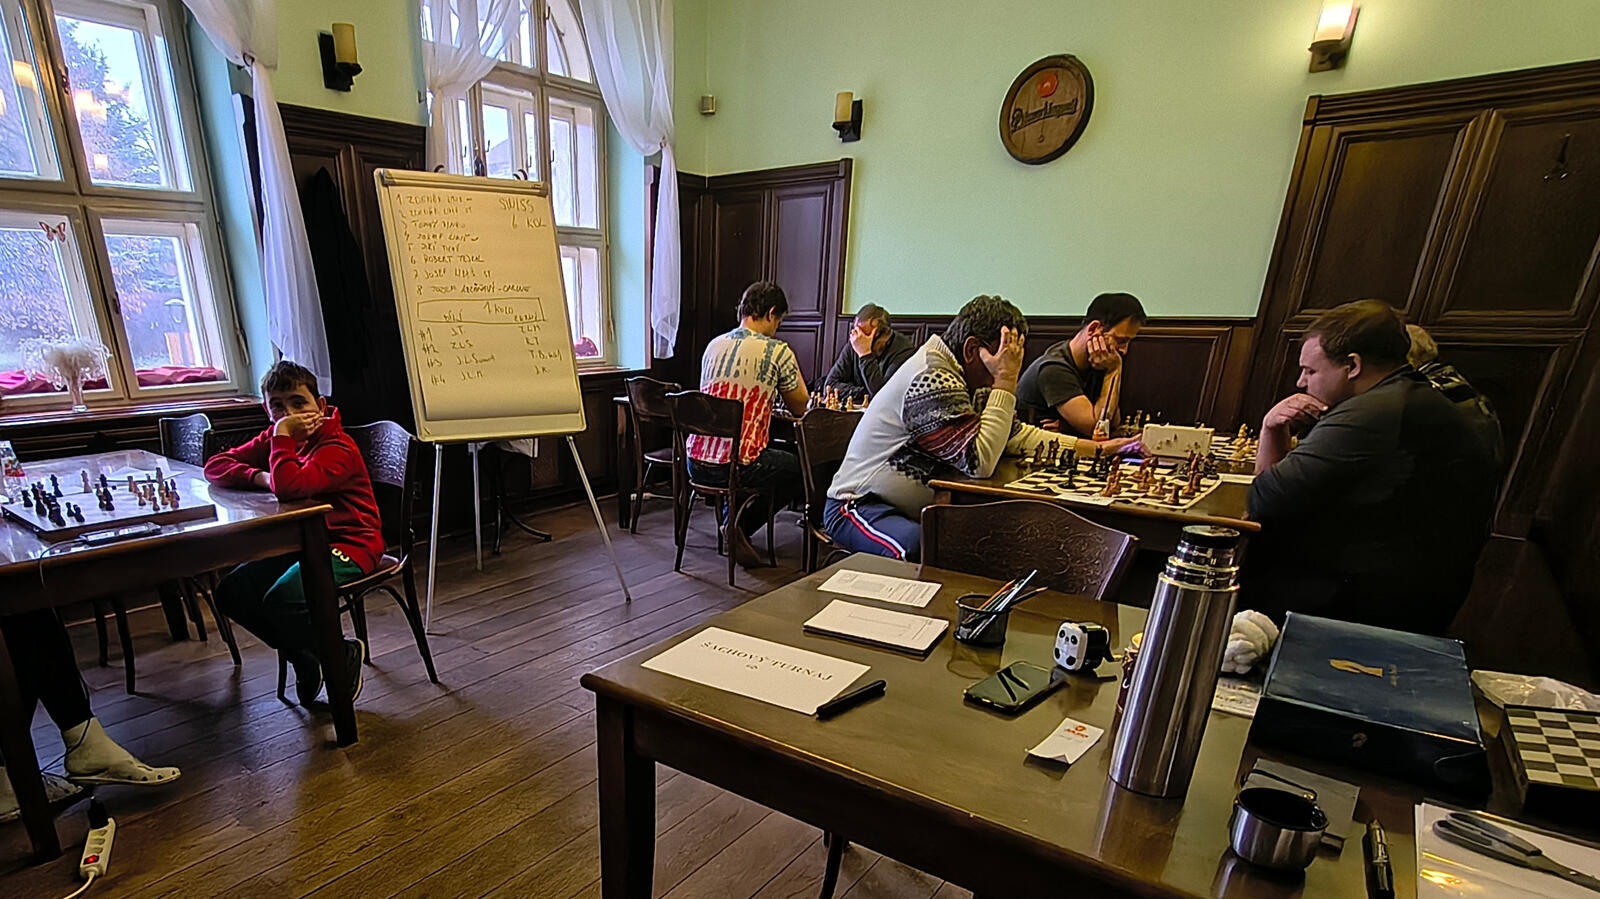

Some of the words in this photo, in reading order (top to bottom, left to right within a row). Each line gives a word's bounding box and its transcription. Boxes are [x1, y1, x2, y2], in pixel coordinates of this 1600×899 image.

[499, 198, 534, 213] SWISS
[423, 254, 453, 265] ROBERT
[483, 301, 492, 315] 1
[494, 303, 514, 315] KOLO
[418, 327, 433, 342] #1
[422, 343, 439, 355] #2
[427, 357, 443, 369] #3
[772, 659, 833, 680] TURNAJ
